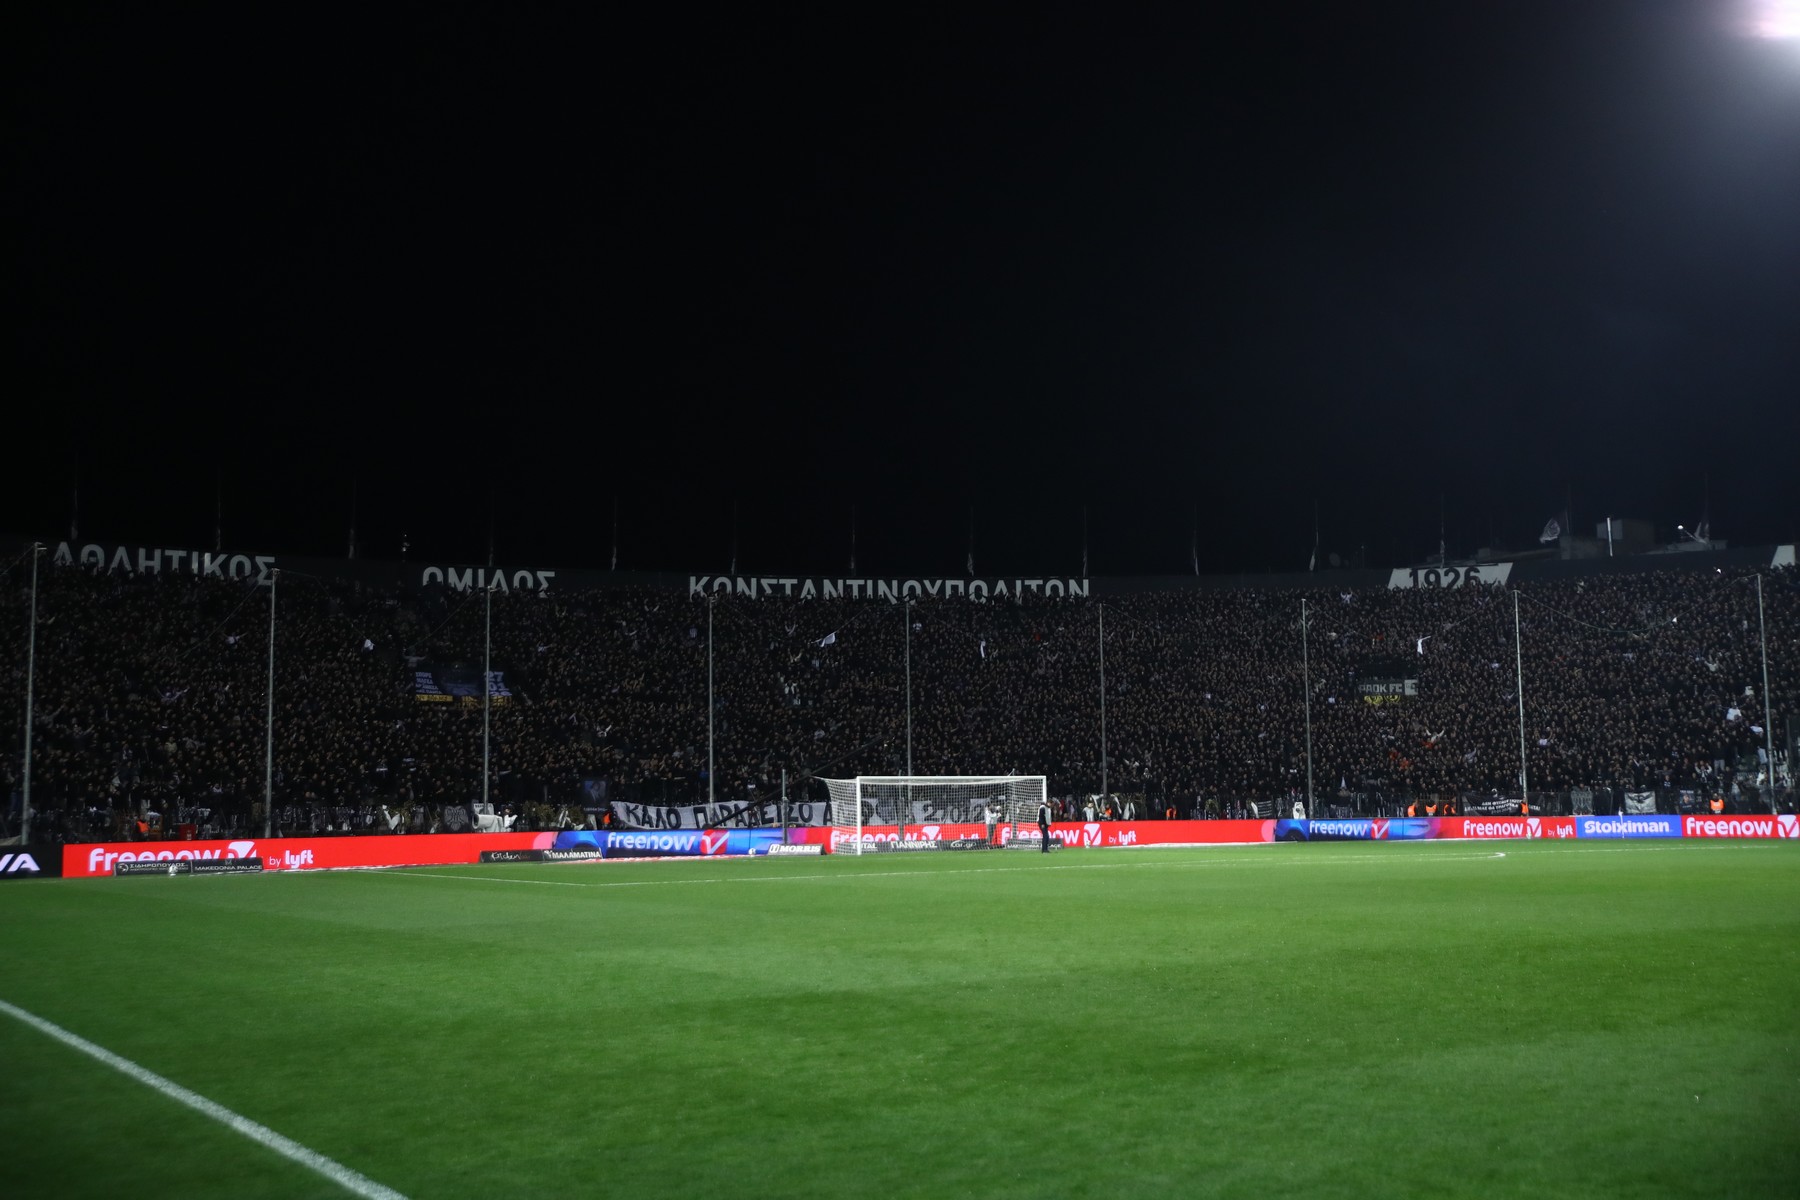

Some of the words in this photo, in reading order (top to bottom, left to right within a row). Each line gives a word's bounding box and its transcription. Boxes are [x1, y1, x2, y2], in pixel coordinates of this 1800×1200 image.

[53, 541, 276, 586] ΑΘΛΗΤΙΚΟΣ
[422, 566, 556, 598] ΟΜΙΛΟΣ
[1409, 566, 1481, 592] 1926
[625, 804, 682, 830] ΚΑΛΟ
[1686, 817, 1772, 835] freenow
[1309, 820, 1368, 836] freenow
[1463, 820, 1523, 836] freenow
[1548, 828, 1555, 836] by
[1556, 825, 1574, 838] lyft
[1584, 820, 1669, 834] Stoiximan
[607, 832, 696, 851] freenow
[1108, 835, 1117, 844] by
[1118, 830, 1137, 846] lyft
[779, 845, 821, 853] MORRIS
[269, 856, 281, 867] by
[285, 849, 314, 869] lyft
